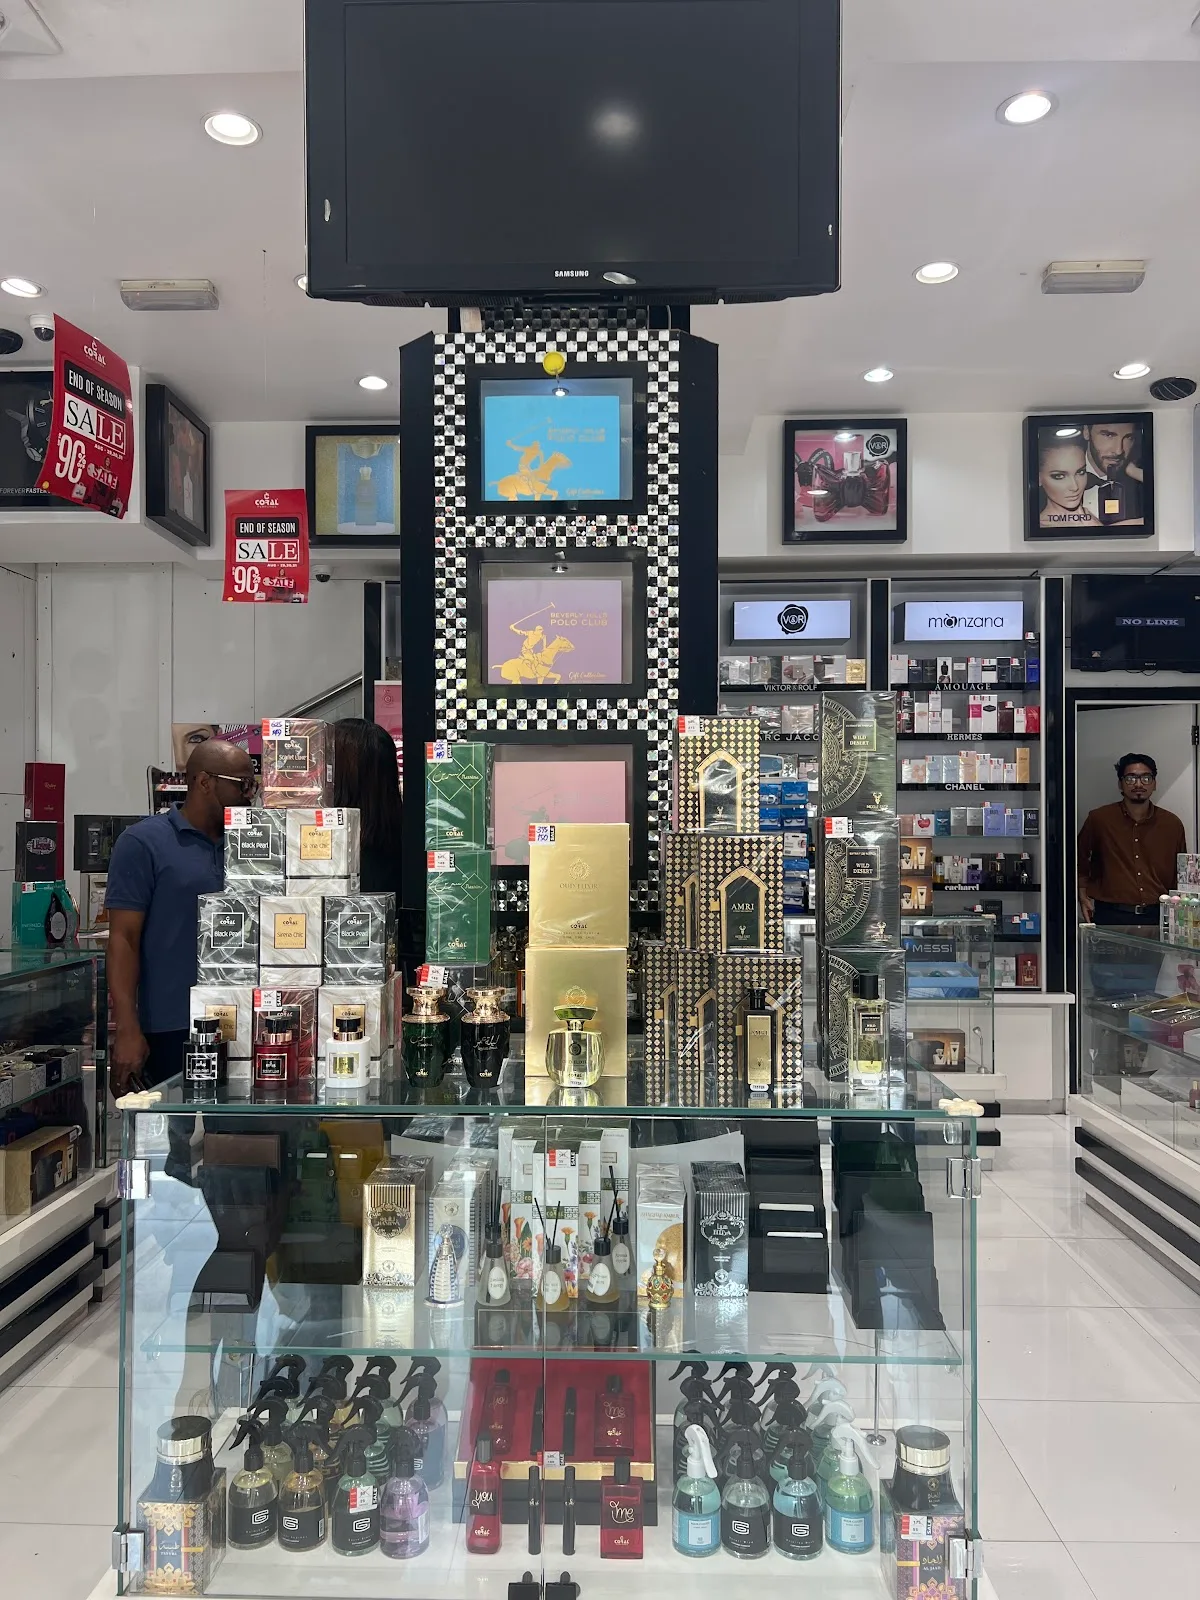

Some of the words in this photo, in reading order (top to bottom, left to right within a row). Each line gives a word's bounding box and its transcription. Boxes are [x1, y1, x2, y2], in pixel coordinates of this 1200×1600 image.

[68, 369, 84, 391] END
[85, 379, 95, 397] OF
[96, 385, 123, 412] SEASON
[66, 399, 124, 450] SALE
[1047, 513, 1067, 522] TOM
[1067, 513, 1092, 522] FORD
[239, 522, 254, 533] END
[256, 522, 266, 533] OF
[267, 522, 296, 533] SEASON
[238, 541, 298, 560] SALE
[783, 614, 804, 625] V&R
[763, 684, 792, 692] VIKTOR
[935, 683, 992, 691] AMOUAGE
[945, 783, 985, 792] CHANEL
[944, 883, 980, 891] cacharel
[603, 1401, 626, 1419] me
[472, 1489, 494, 1509] you
[609, 1500, 635, 1524] me
